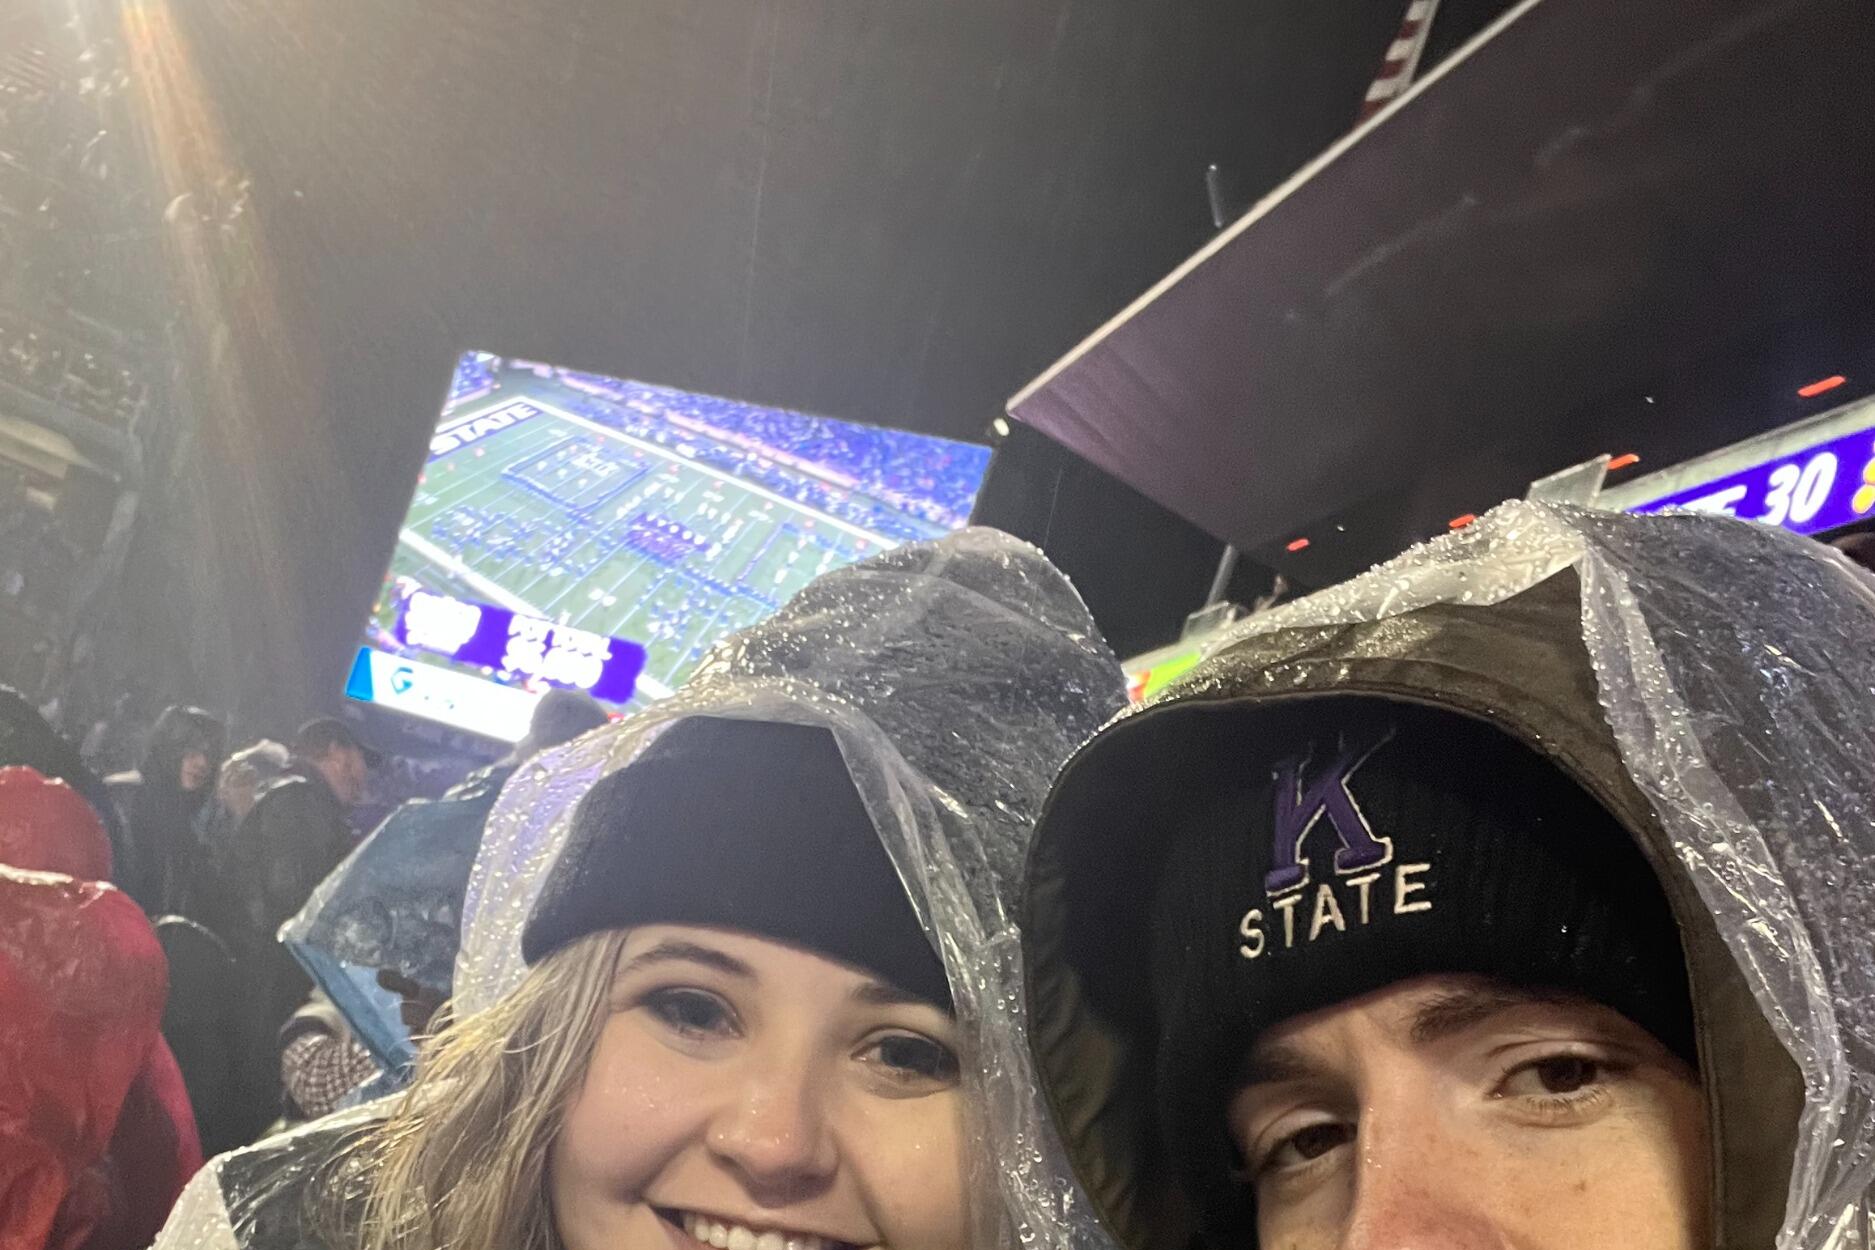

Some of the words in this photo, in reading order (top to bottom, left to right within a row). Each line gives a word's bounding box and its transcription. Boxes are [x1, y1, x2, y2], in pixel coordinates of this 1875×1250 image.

[429, 403, 539, 455] STATE
[1757, 452, 1837, 526] 30
[1264, 730, 1396, 897] K
[1240, 863, 1432, 959] STATE
